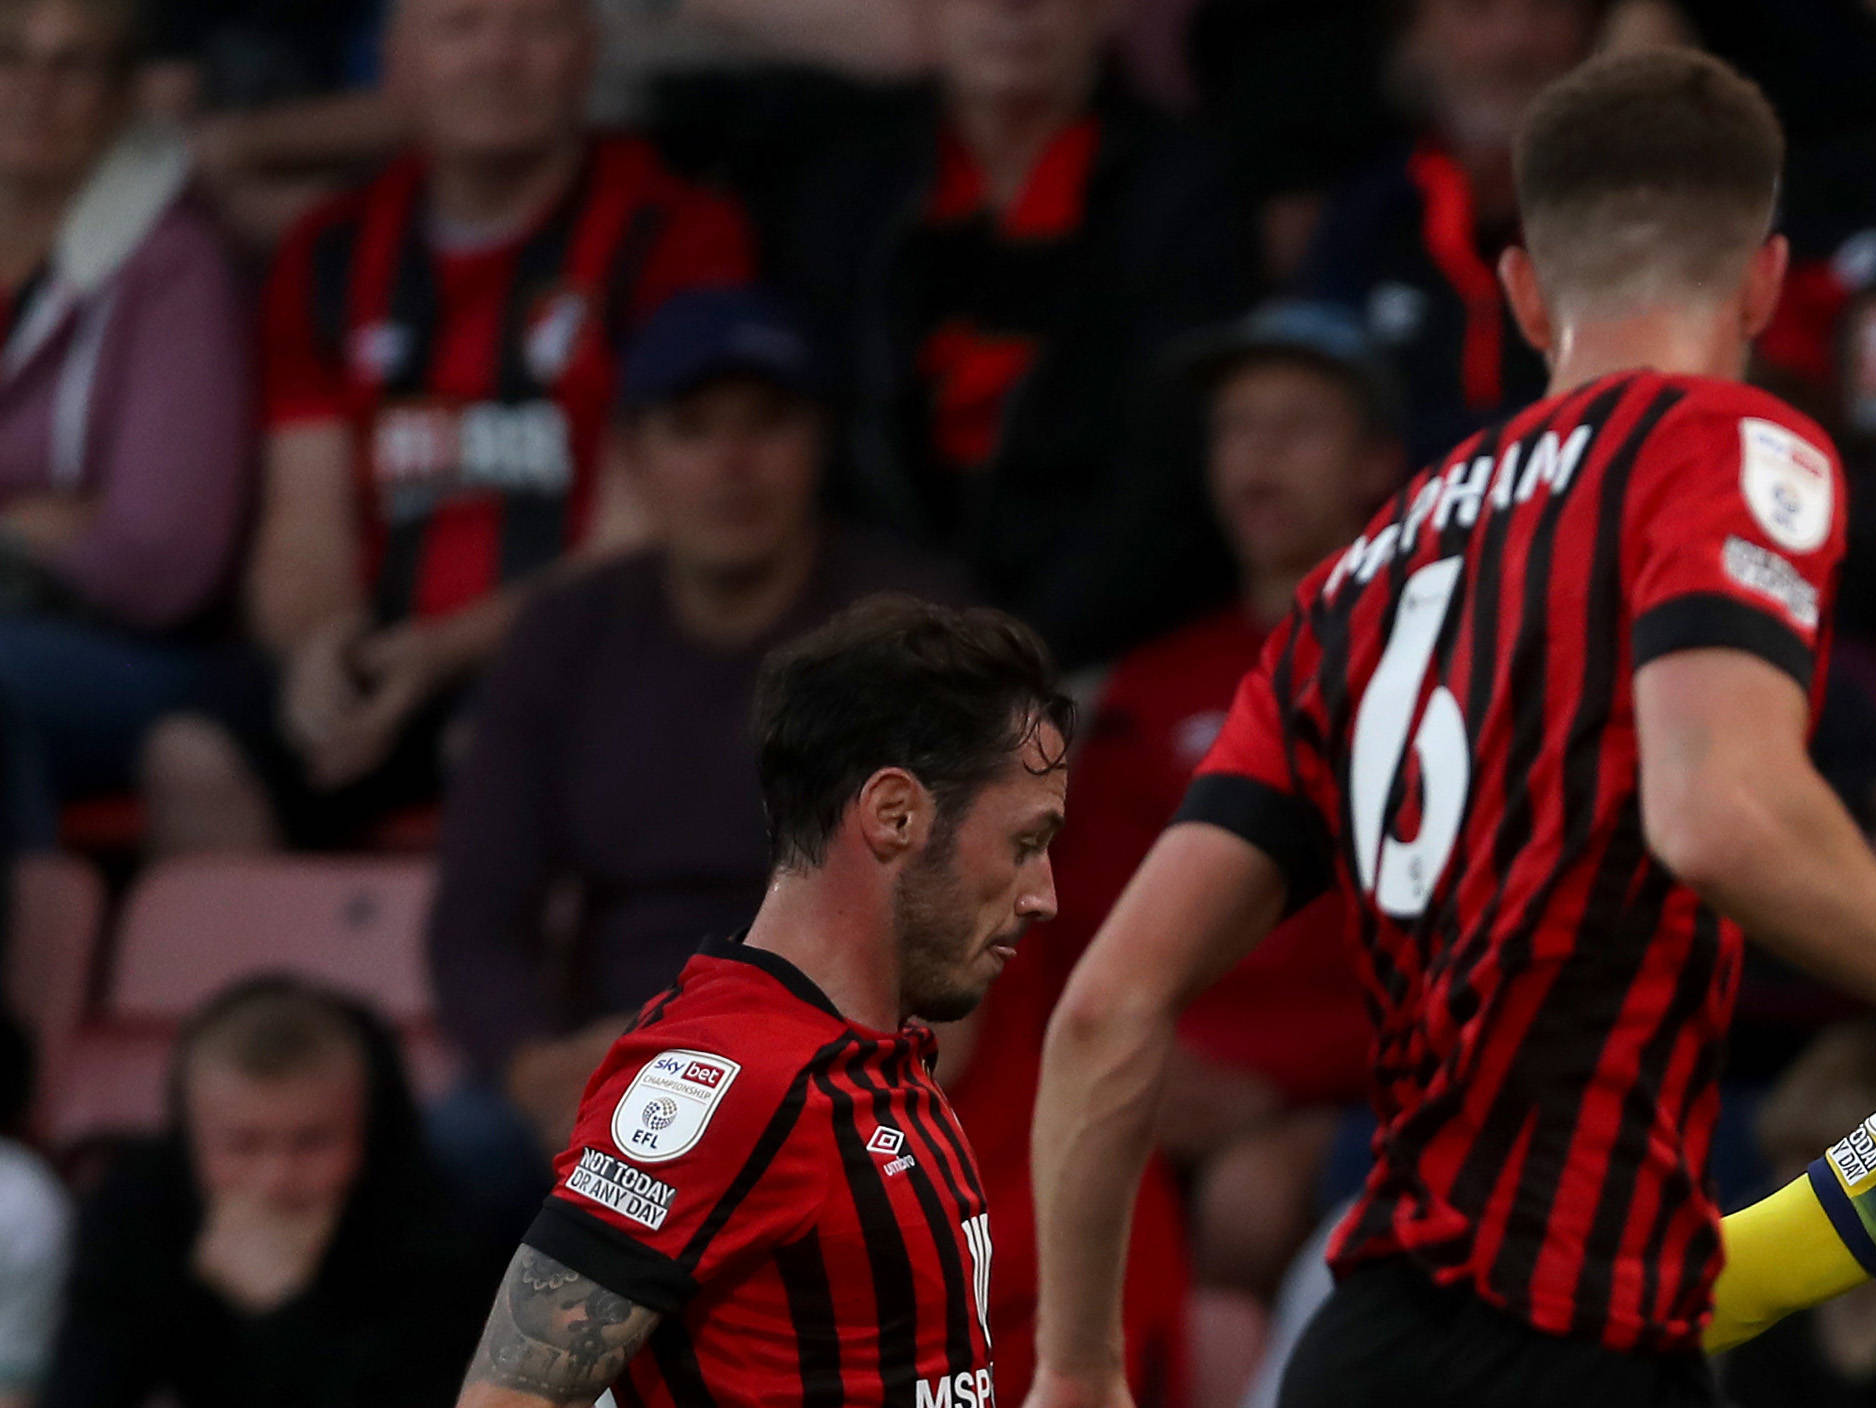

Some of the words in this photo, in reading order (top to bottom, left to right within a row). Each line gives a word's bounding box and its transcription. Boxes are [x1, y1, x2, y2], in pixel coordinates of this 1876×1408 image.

[1350, 556, 1471, 917] 6
[654, 1057, 685, 1075] sky
[687, 1064, 721, 1085] bet
[643, 1075, 713, 1100] CHAMPIONSHIP
[632, 1129, 659, 1149] EFL
[579, 1147, 615, 1176] NOT
[613, 1160, 677, 1206] TODAY
[1838, 1152, 1866, 1180] DAY
[570, 1168, 593, 1192] OR
[587, 1176, 627, 1208] ANY
[626, 1197, 665, 1225] DAY
